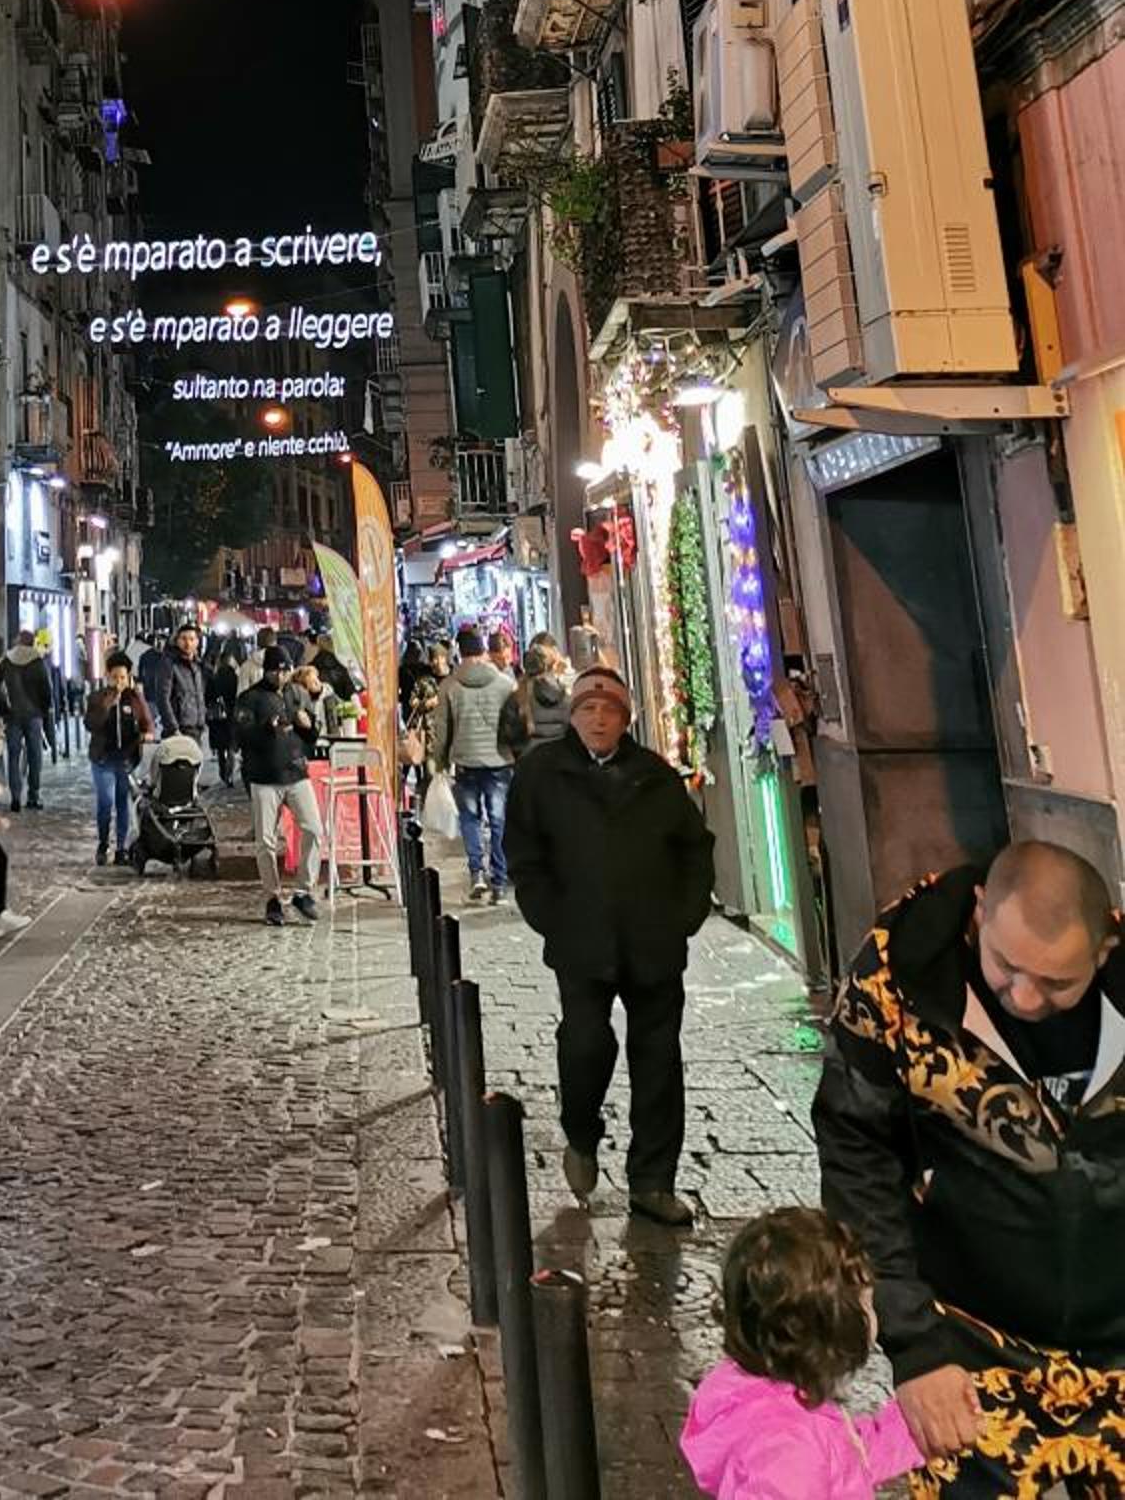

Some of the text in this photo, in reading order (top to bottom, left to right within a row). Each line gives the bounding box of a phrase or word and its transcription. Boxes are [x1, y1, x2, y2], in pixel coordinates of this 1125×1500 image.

[31, 224, 382, 281] e s'è mparato a scrivere,
[90, 305, 394, 350] e s'è mparato a lleggere
[172, 371, 346, 404] sultanto na parola:
[244, 441, 255, 457] e
[258, 435, 304, 457] niente
